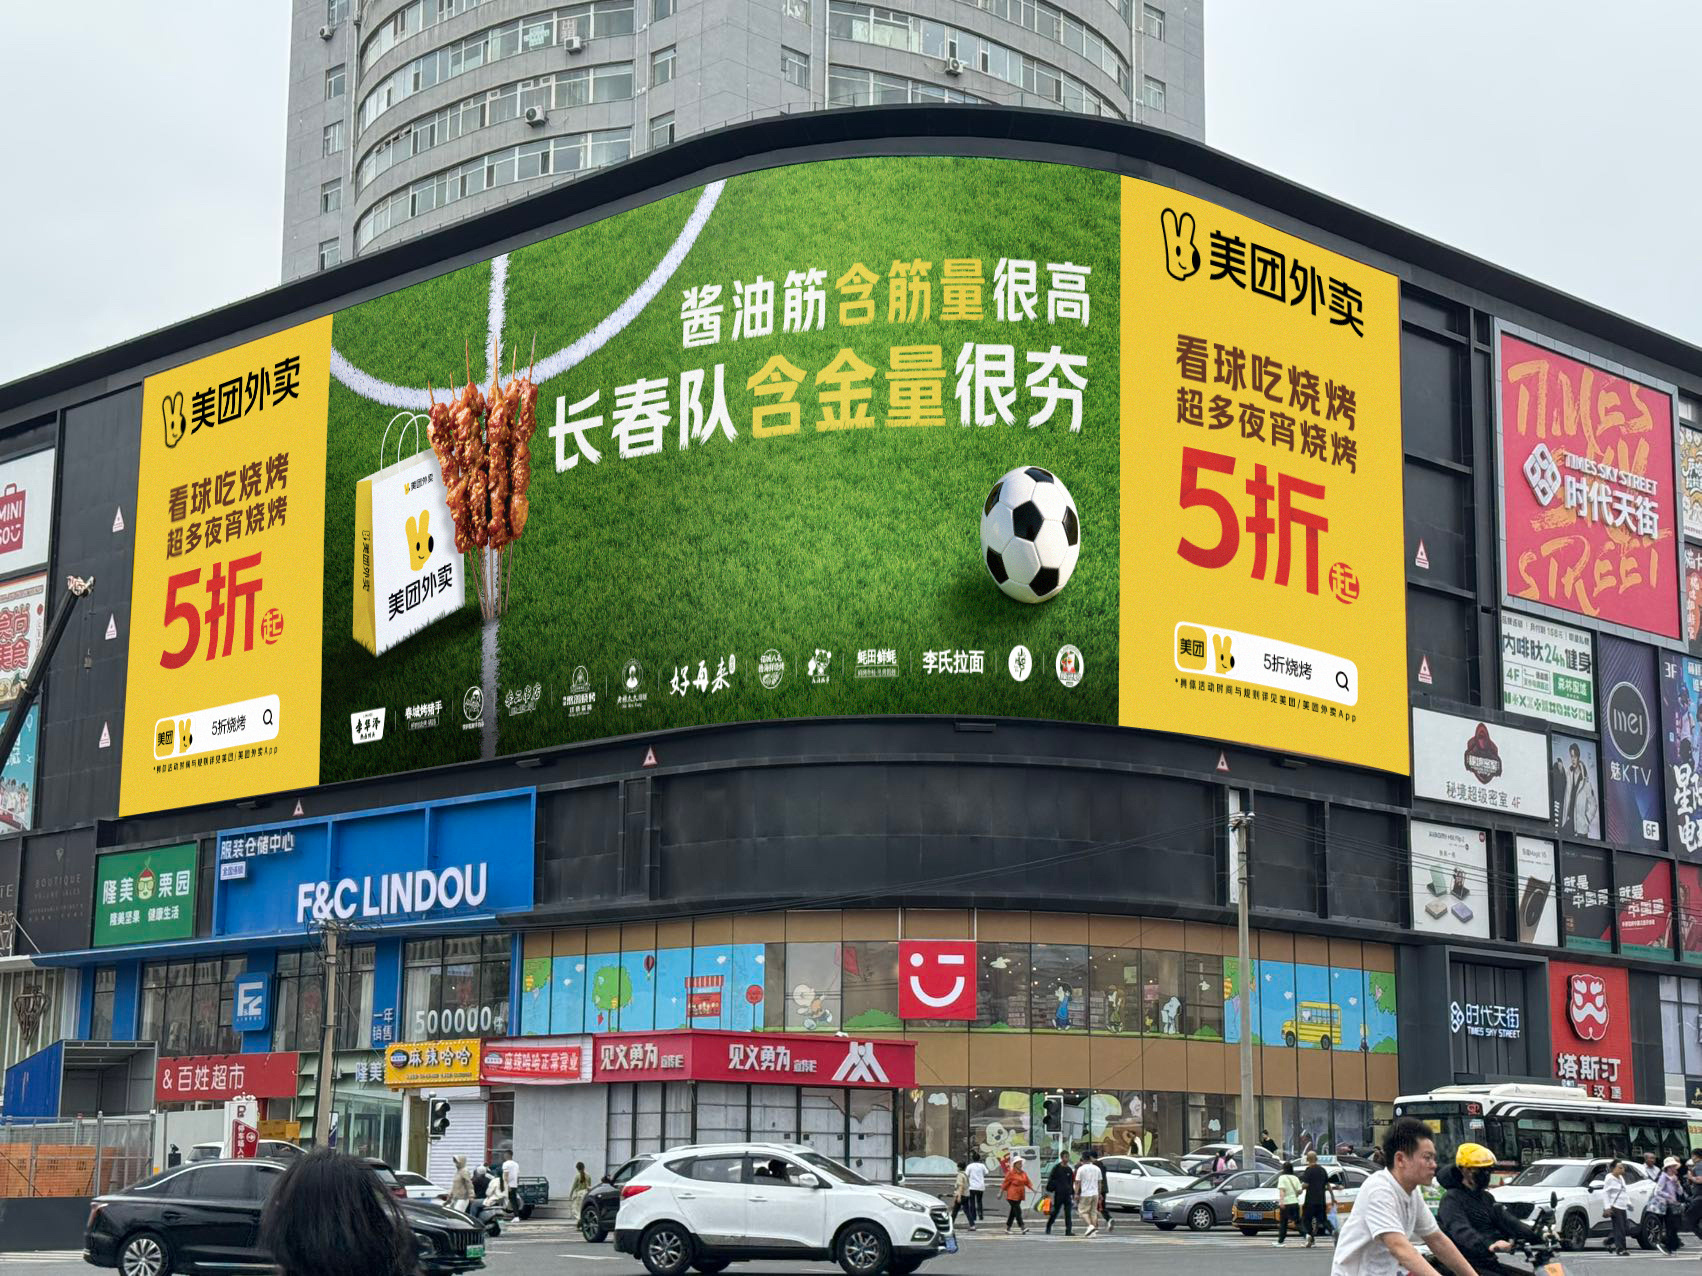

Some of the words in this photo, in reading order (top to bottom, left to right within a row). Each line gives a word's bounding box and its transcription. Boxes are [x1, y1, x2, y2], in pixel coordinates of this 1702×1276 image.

[1209, 229, 1364, 338] 美团外卖
[679, 257, 1092, 349] 酱油筋含筋量很高
[191, 355, 300, 435] 美团外卖
[1176, 333, 1356, 431] 看球吃烧烤
[548, 342, 1088, 473] 长春队含金量很夯
[1176, 386, 1357, 474] 超多夜宵烧烤
[168, 452, 289, 523] 看球吃烧烤
[410, 473, 434, 491] 美团外卖
[1564, 451, 1598, 475] TIMES
[1599, 461, 1619, 483] SKY
[1619, 465, 1658, 496] STREET
[1177, 446, 1328, 596] 5折
[1564, 475, 1658, 539] 时代天街
[166, 495, 288, 560] 超多夜宵烧烤
[388, 563, 453, 621] 美团外卖
[159, 551, 263, 669] 5折
[922, 649, 985, 675] 李氏拉面
[1180, 637, 1204, 658] 美团
[1263, 652, 1312, 681] 5折烧烤
[1506, 668, 1519, 681] 4F
[157, 730, 173, 746] 美团
[211, 714, 246, 735] 5折烧烤
[1610, 761, 1651, 786] 魅KTV
[1446, 781, 1508, 808] 秘境超级密室
[1645, 823, 1657, 837] 6F
[221, 832, 294, 860] 服装仓储中心
[103, 877, 134, 905] 隆美
[296, 878, 357, 923] F&C
[363, 862, 488, 917] LINDOU
[1466, 1003, 1519, 1028] 时代天街
[1467, 1025, 1484, 1036] TIMES
[1498, 1028, 1520, 1039] STREET
[355, 1062, 383, 1082] 隆美
[408, 1046, 473, 1068] 麻辣哈哈
[601, 1043, 658, 1071] 见义勇为
[728, 1044, 790, 1072] 见义勇为
[1558, 1052, 1621, 1082] 塔斯汀
[177, 1063, 246, 1092] 百姓超市
